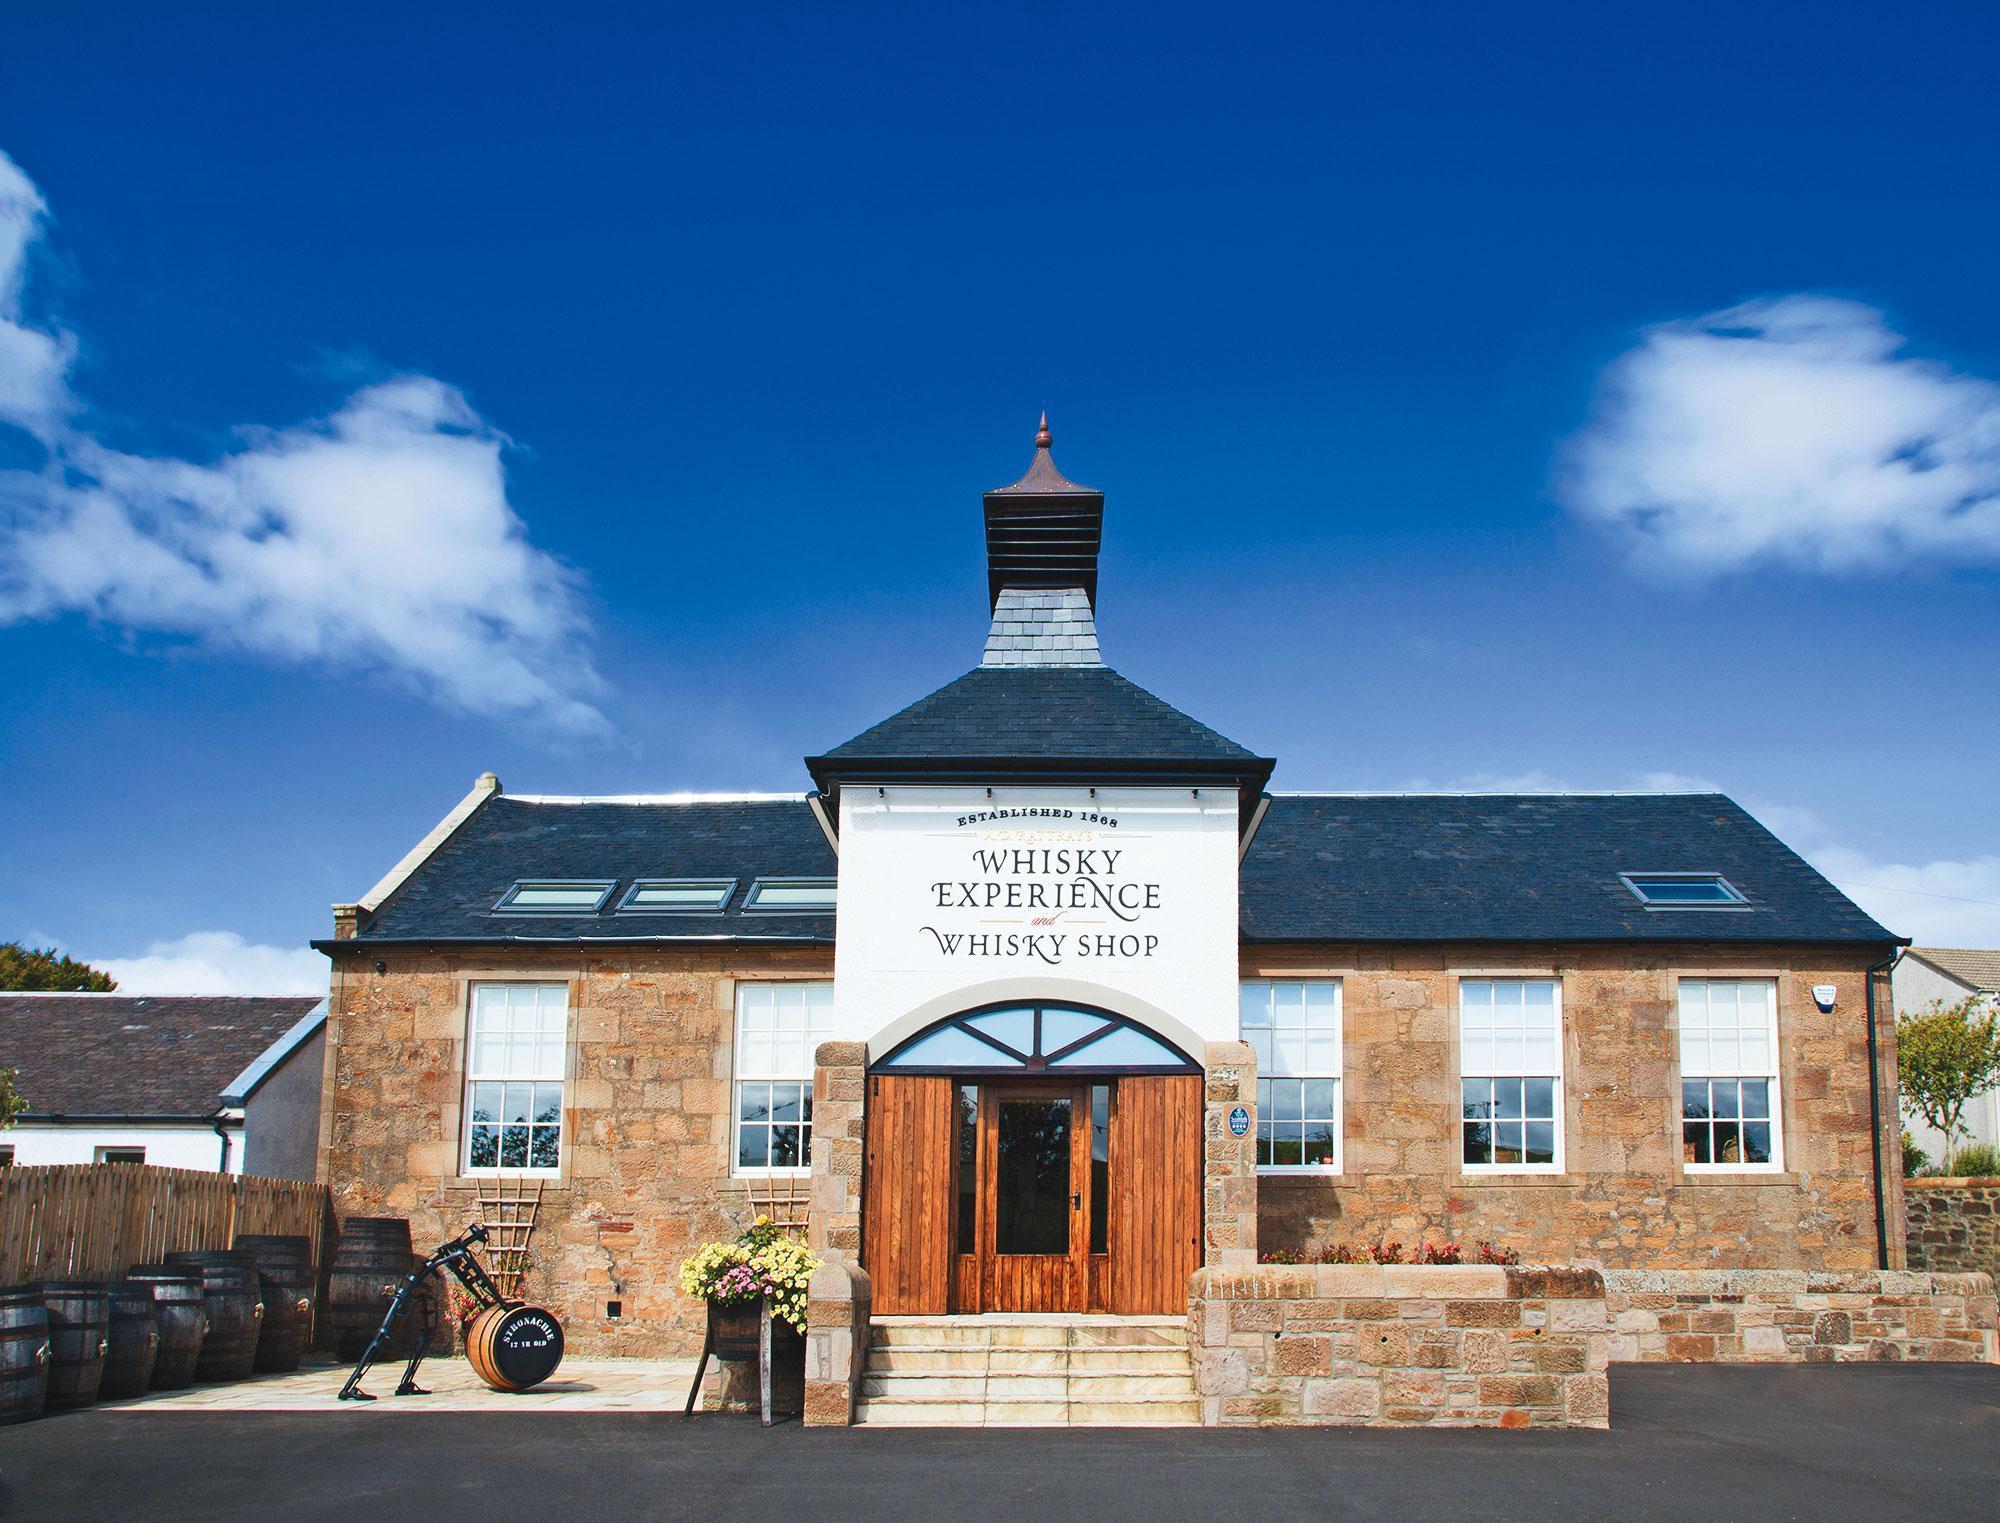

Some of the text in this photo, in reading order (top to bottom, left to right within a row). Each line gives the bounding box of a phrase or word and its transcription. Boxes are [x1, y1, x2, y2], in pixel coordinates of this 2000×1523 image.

[957, 808, 1119, 828] ESTABLISHED 1868
[972, 849, 1122, 875] WHISKY
[931, 876, 1161, 922] EXPERIENCE
[1030, 911, 1068, 926] and
[918, 926, 1159, 964] WHISKY SHOP
[503, 1317, 554, 1343] STRONACHIE
